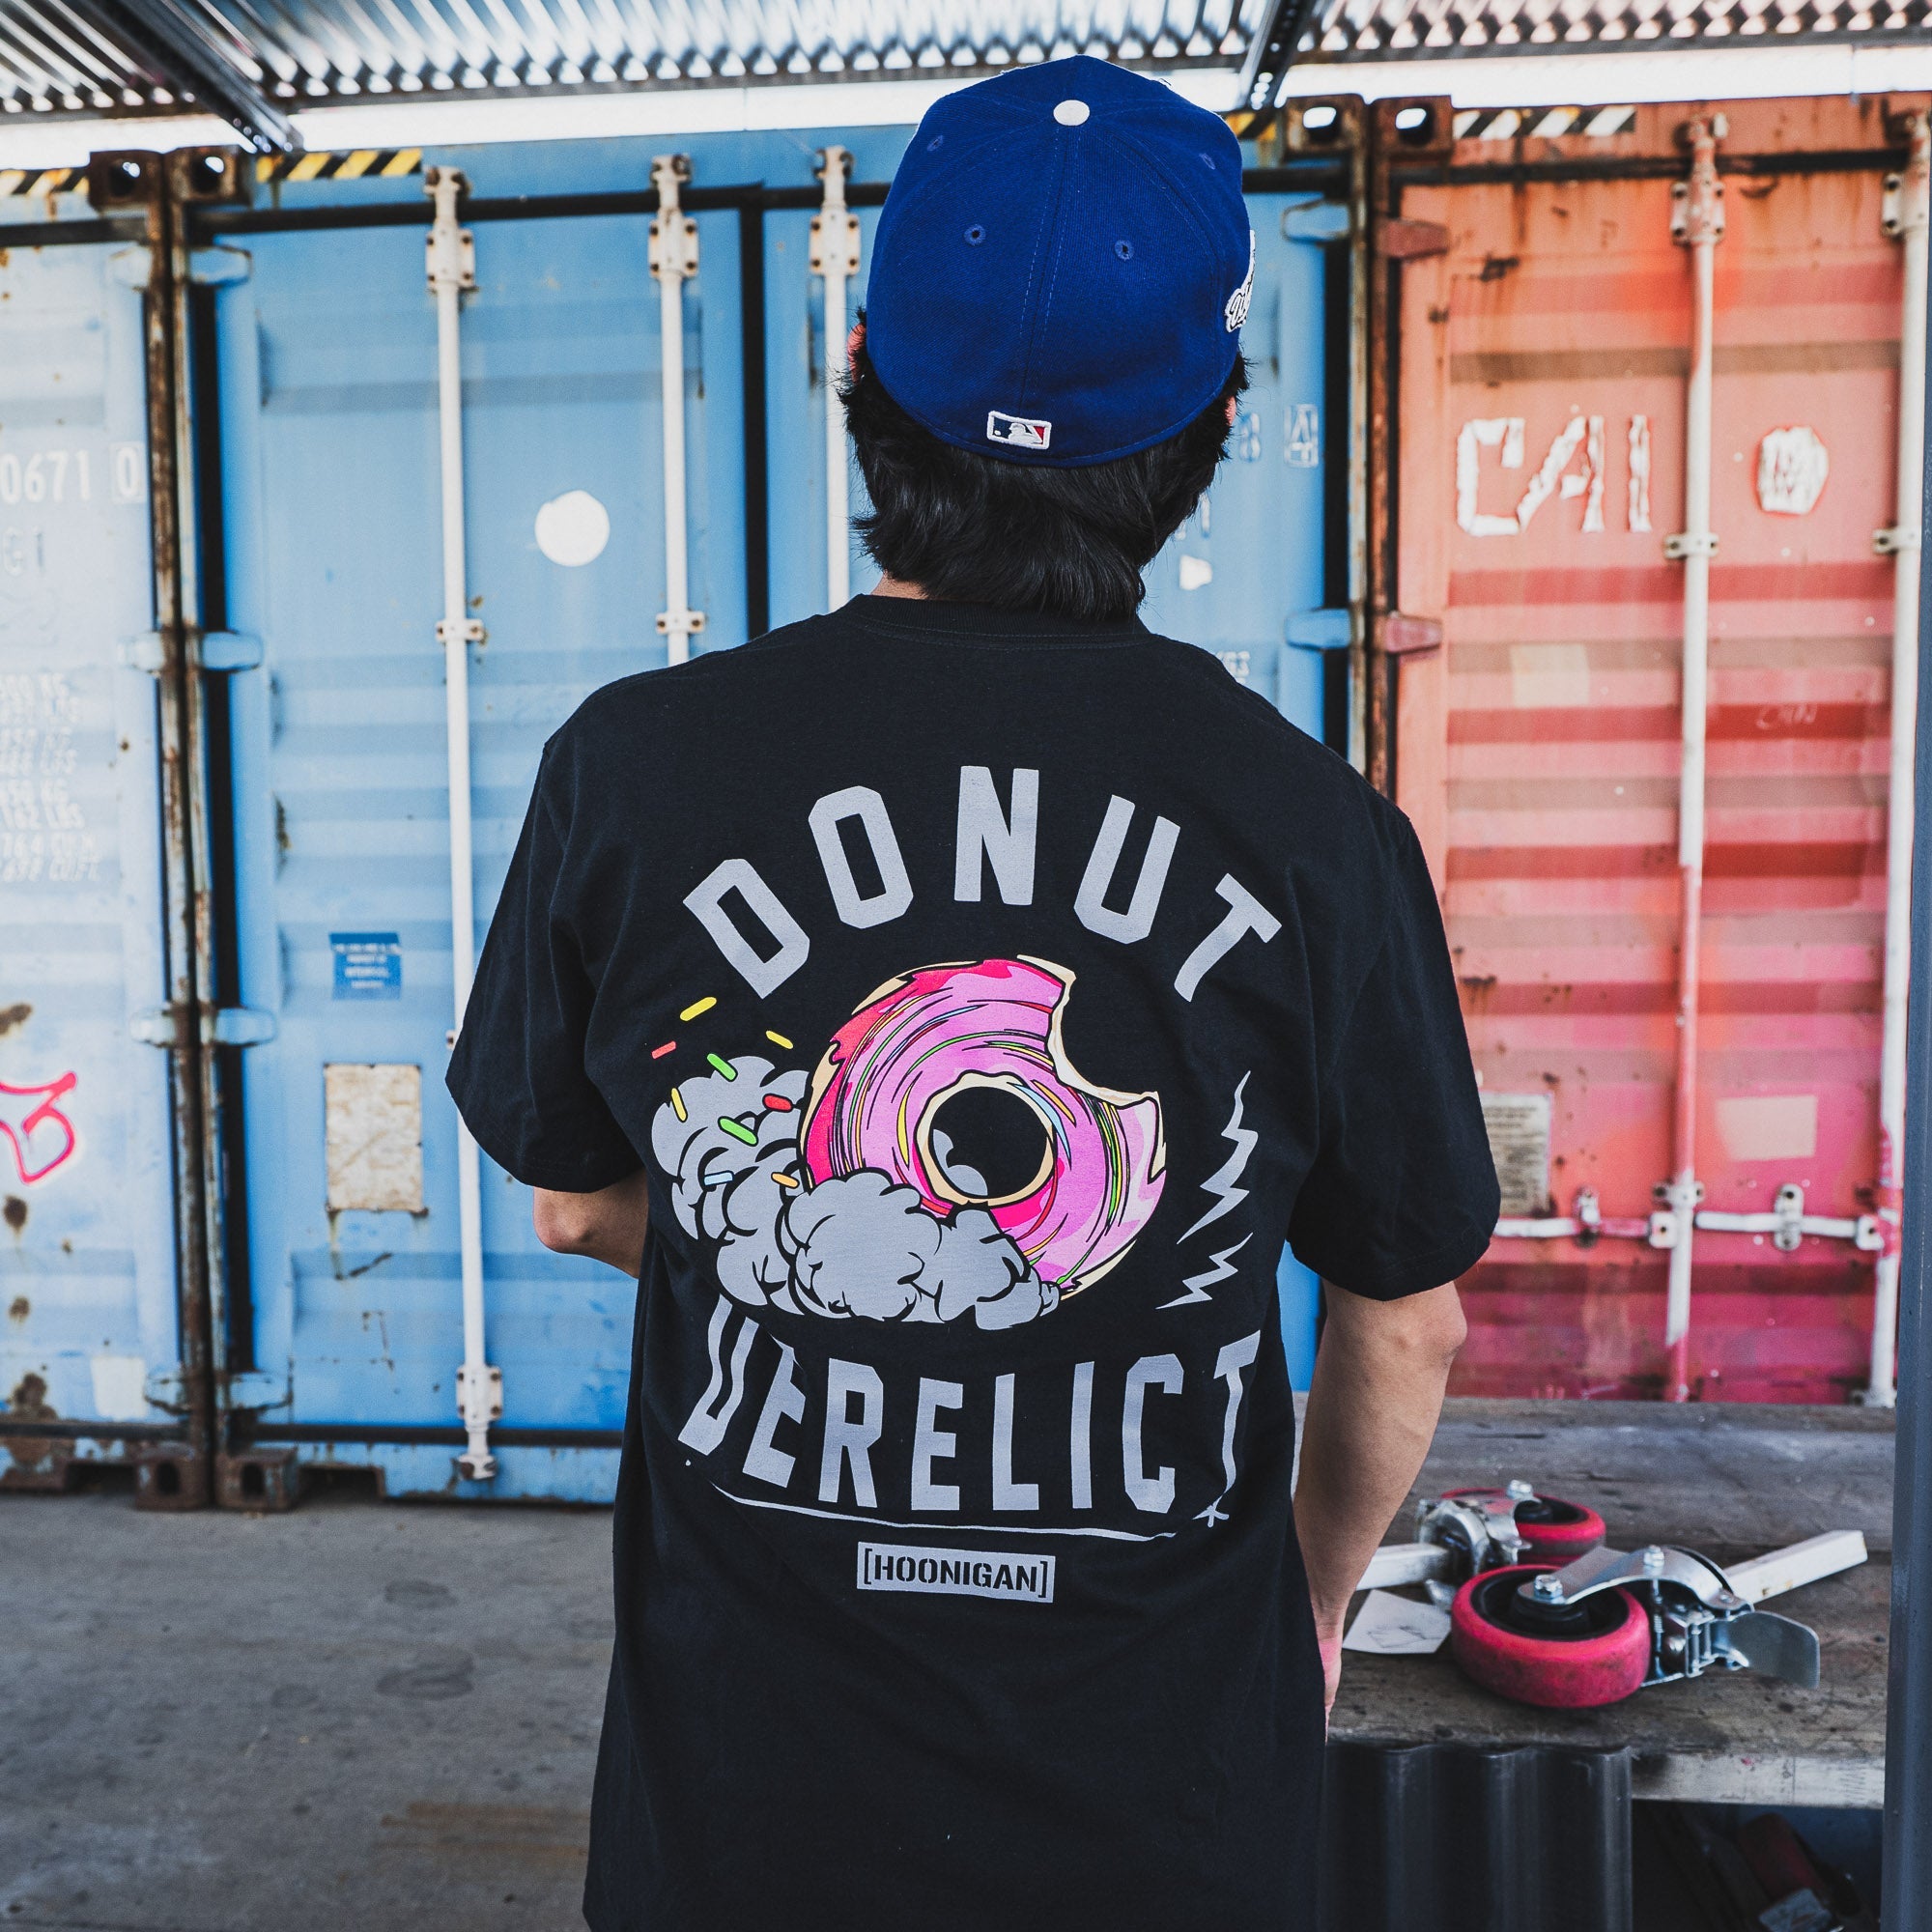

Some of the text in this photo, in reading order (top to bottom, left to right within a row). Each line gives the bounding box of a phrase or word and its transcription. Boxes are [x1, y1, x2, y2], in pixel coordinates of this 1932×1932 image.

[0, 449, 92, 504] 0671
[683, 766, 1282, 1002] DONUT
[678, 1293, 1260, 1515] DERELICT
